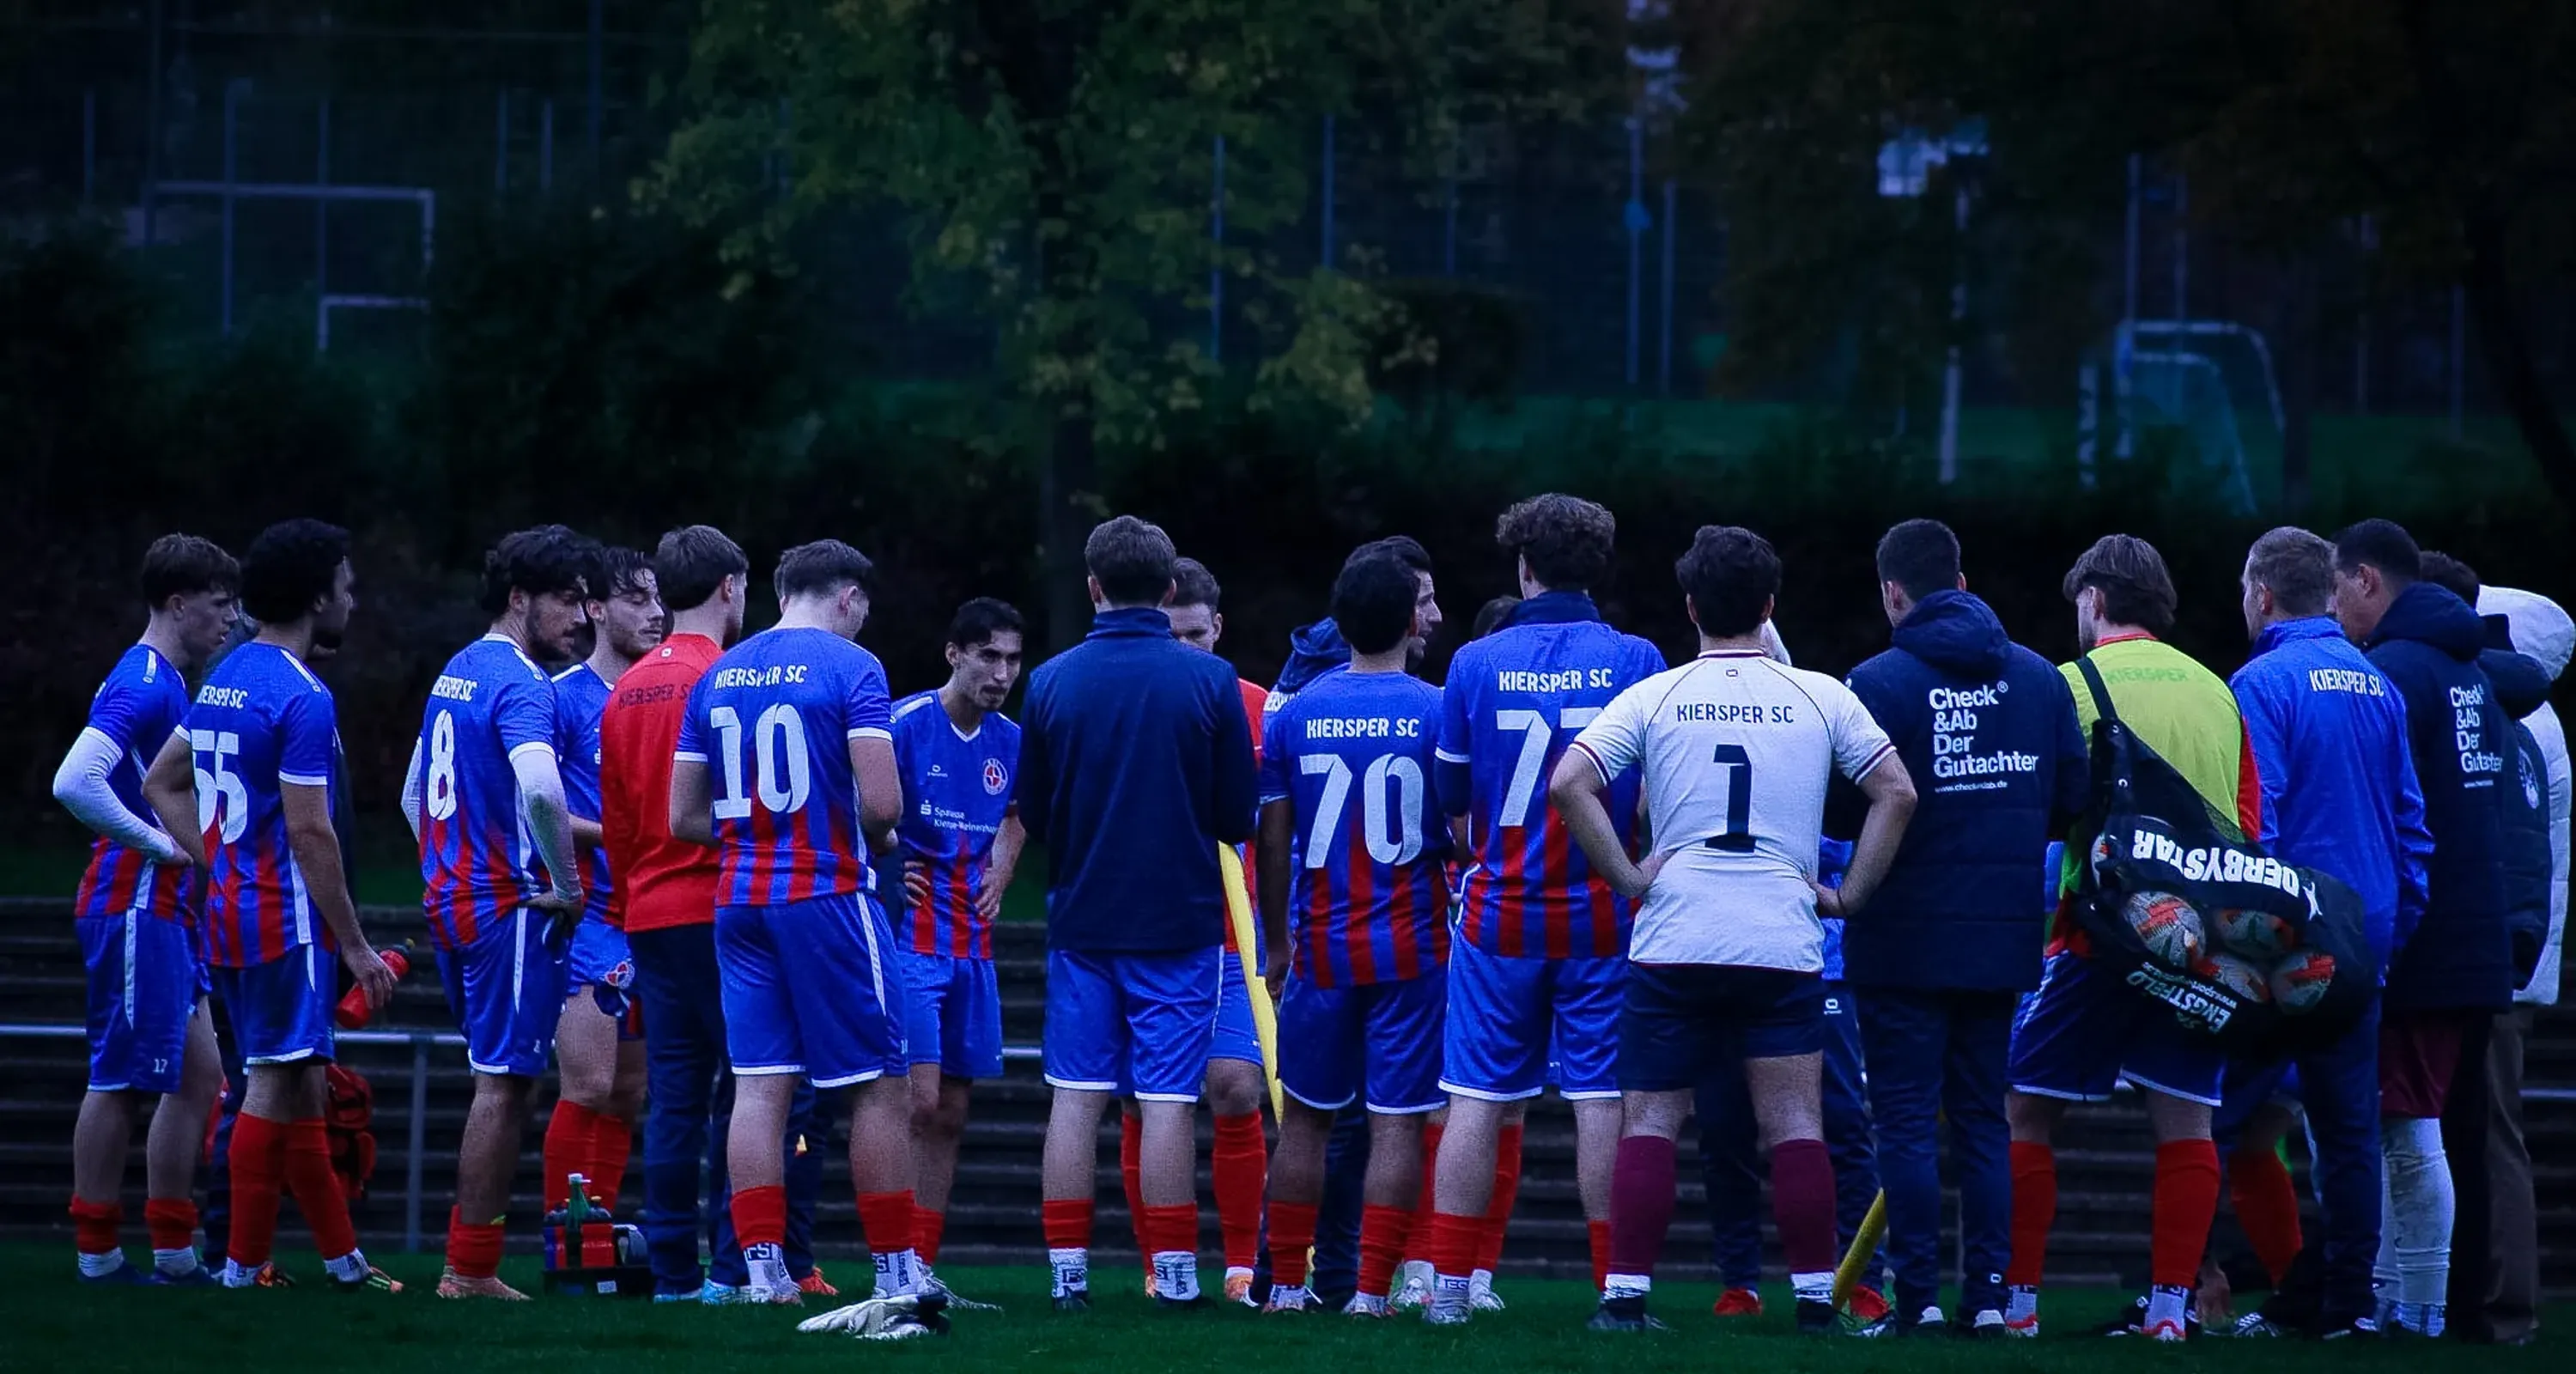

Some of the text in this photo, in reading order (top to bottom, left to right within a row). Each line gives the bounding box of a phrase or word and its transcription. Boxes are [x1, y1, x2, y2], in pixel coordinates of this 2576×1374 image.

[784, 665, 808, 684] SC
[1498, 668, 1613, 693] KIERSPER SC
[2308, 669, 2368, 696] KIERSPER
[229, 688, 248, 709] SC
[1676, 703, 1795, 724] KIERSPER SC
[1933, 708, 1978, 733] &Ab
[2456, 707, 2481, 730] &Ab
[1306, 718, 1420, 739] KIERSPER SC
[1933, 733, 1974, 756] Der
[428, 708, 458, 821] 8
[710, 702, 810, 819] 10
[1933, 750, 2039, 778] Gutachter
[1299, 752, 1425, 869] 70
[1704, 744, 1753, 854] 1
[2131, 829, 2300, 898] DERBYSTAR
[152, 1057, 169, 1074] 17
